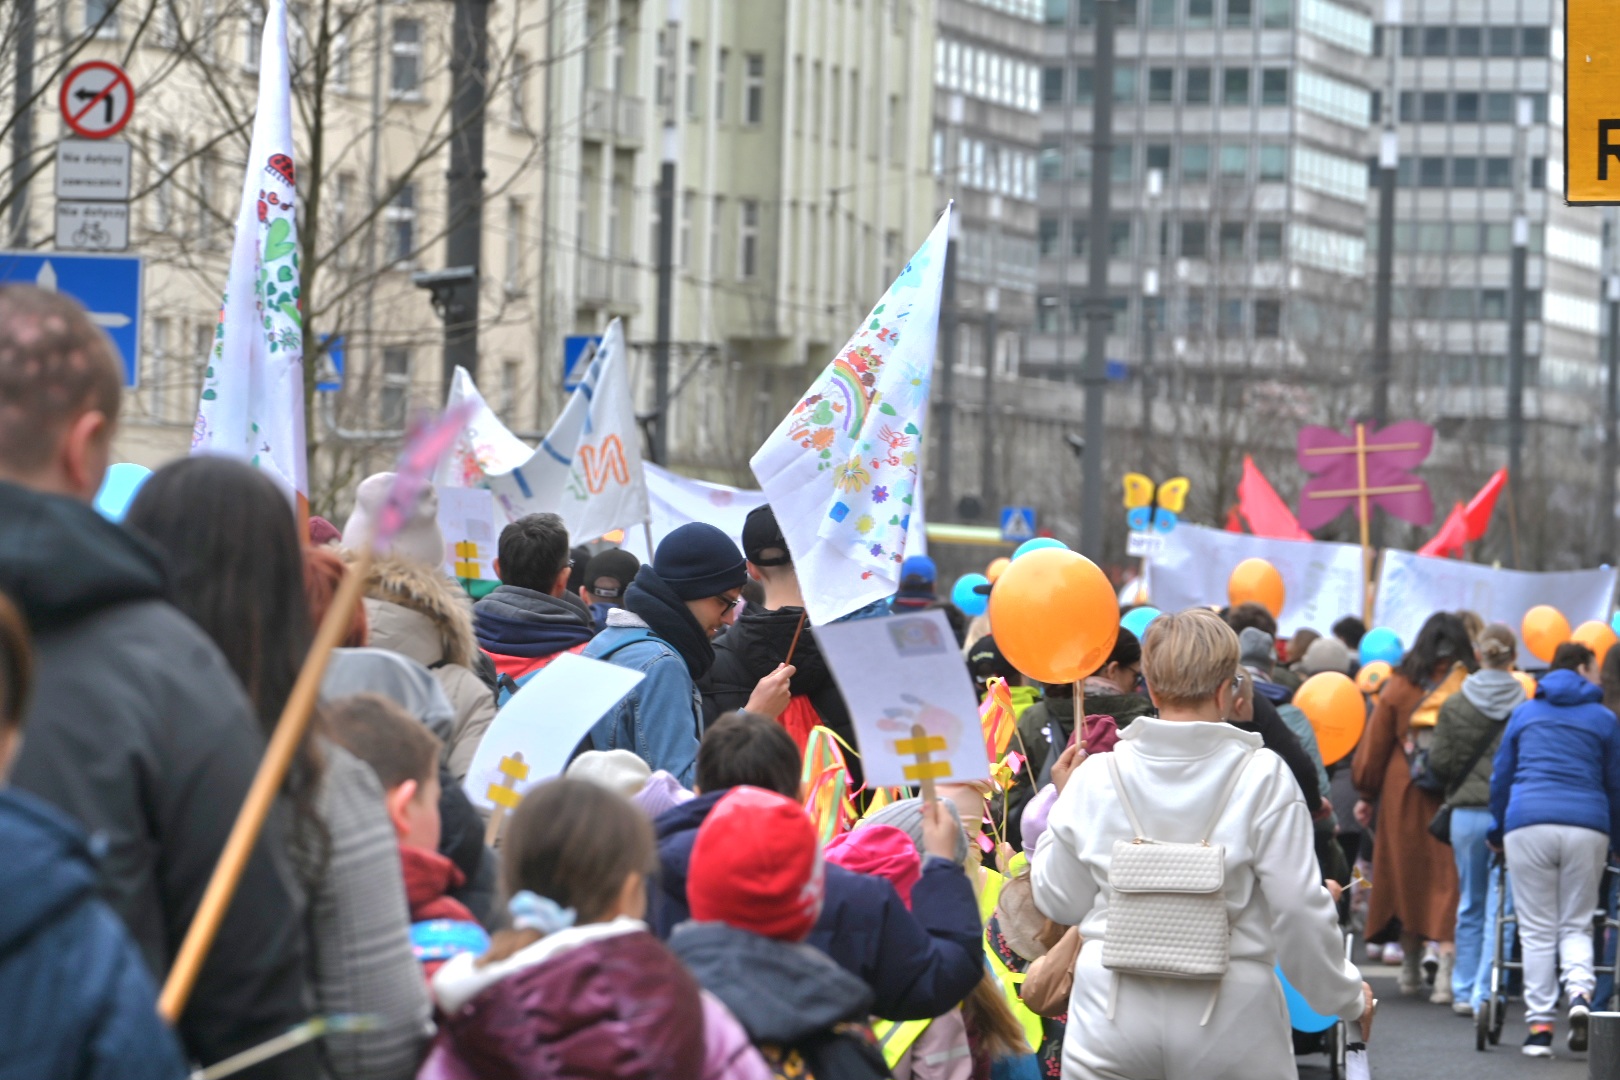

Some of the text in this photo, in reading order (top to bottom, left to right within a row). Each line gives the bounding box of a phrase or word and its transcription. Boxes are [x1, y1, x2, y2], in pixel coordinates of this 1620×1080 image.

[62, 152, 123, 167] Nie dotyczy
[59, 206, 78, 217] Nie
